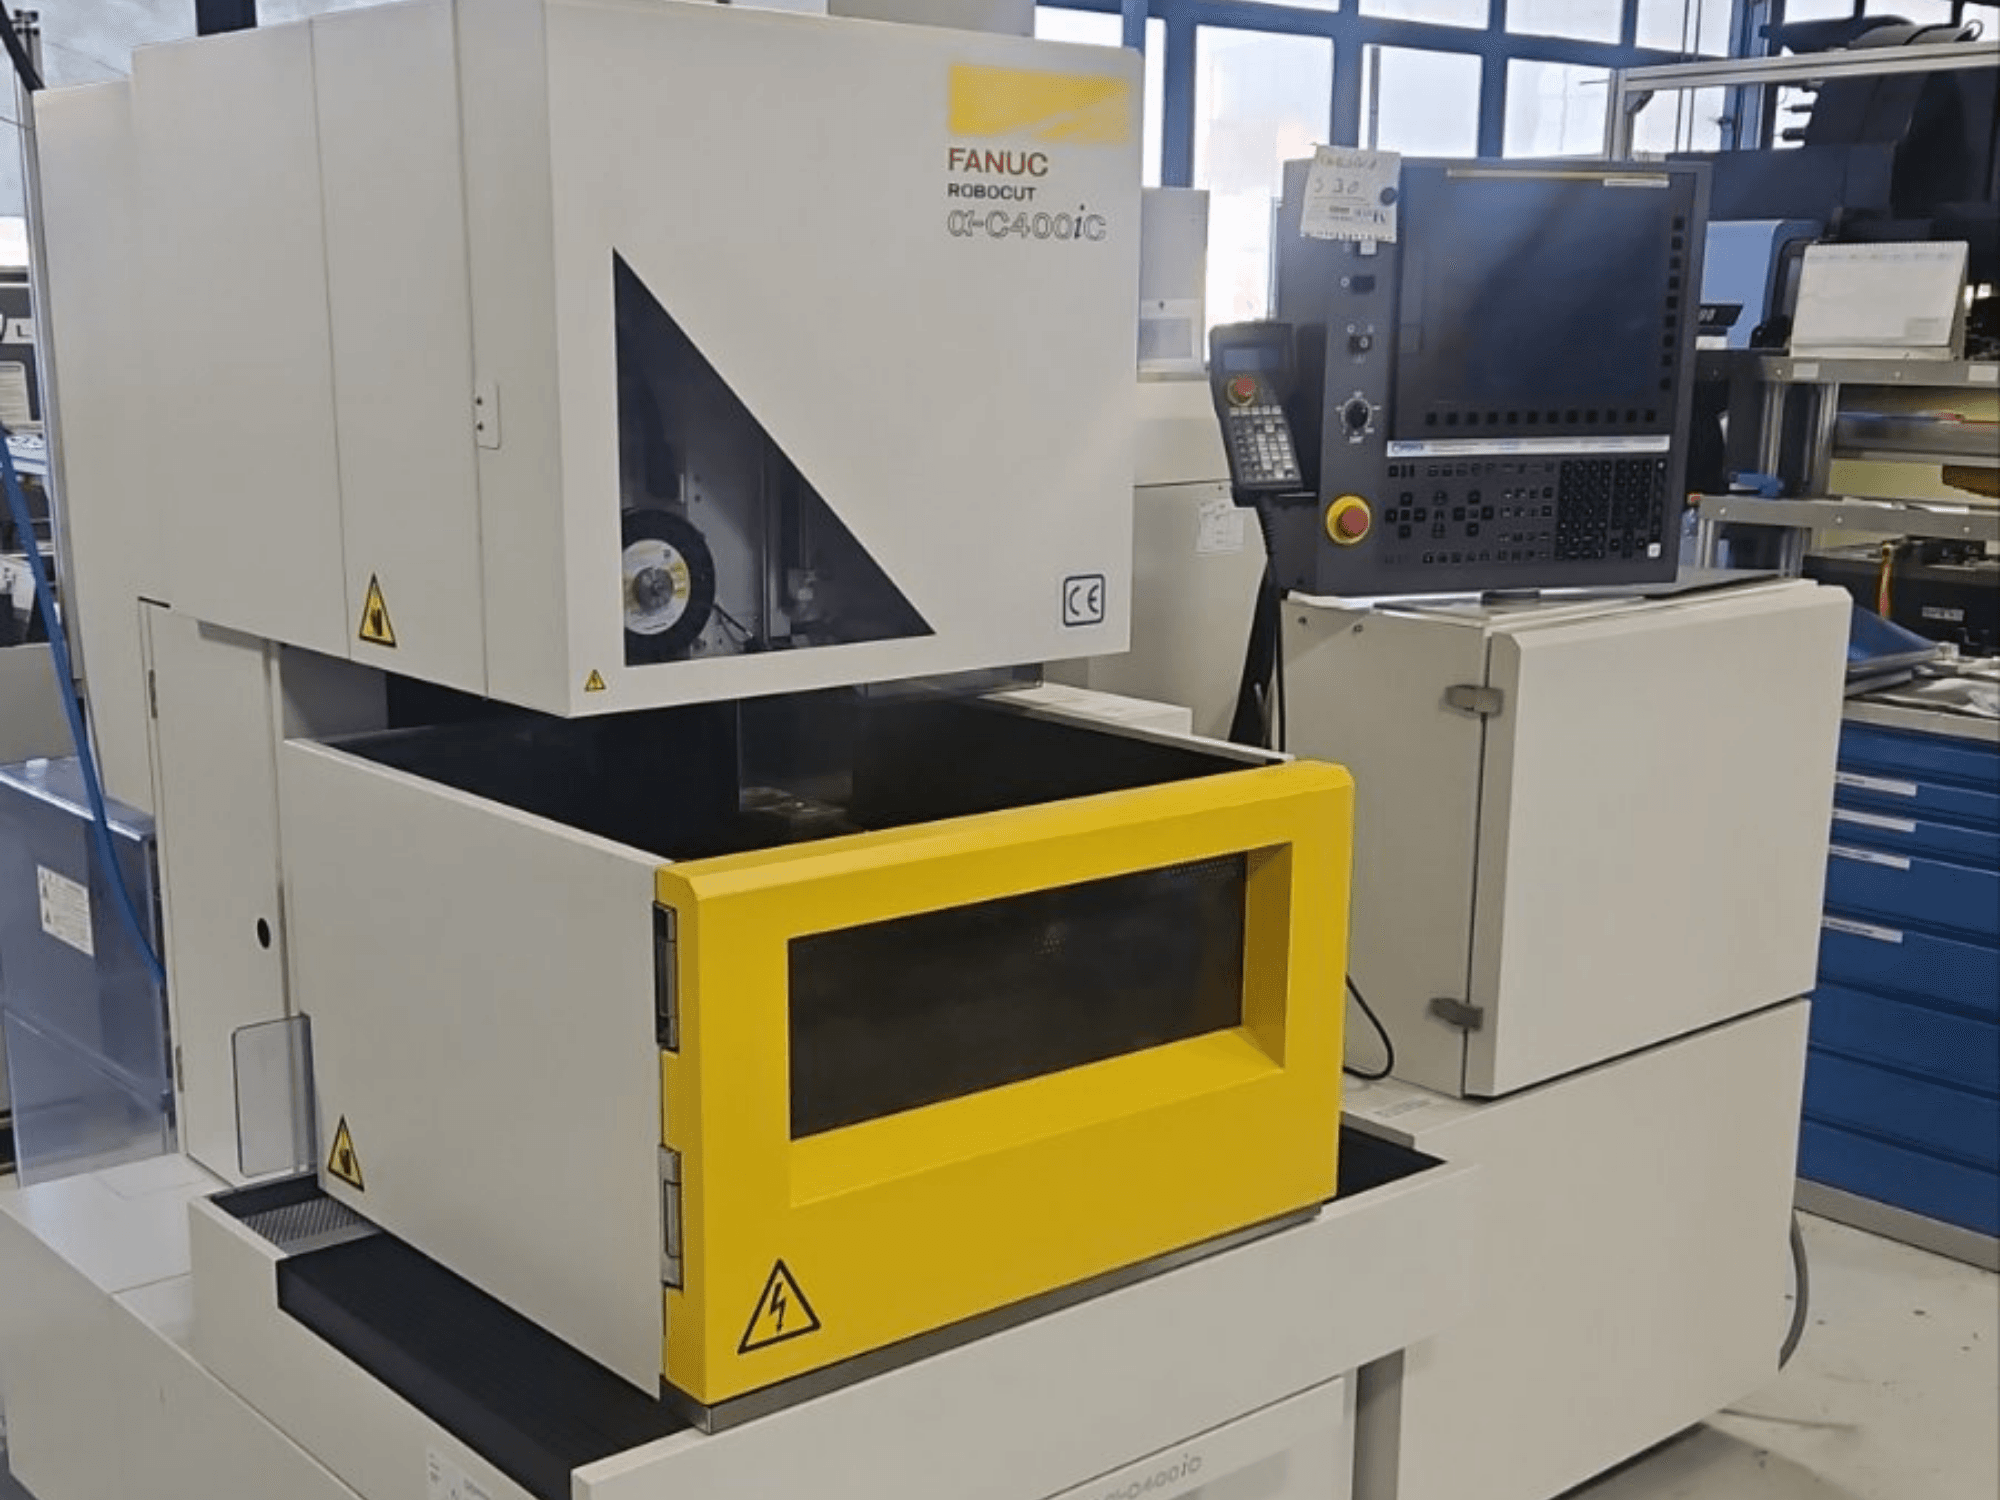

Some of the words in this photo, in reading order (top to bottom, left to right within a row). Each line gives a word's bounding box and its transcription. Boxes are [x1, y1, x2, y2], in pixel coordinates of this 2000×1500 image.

[948, 148, 1049, 177] FANUC
[947, 182, 1037, 202] ROBOCUT
[1068, 584, 1100, 617] CE
